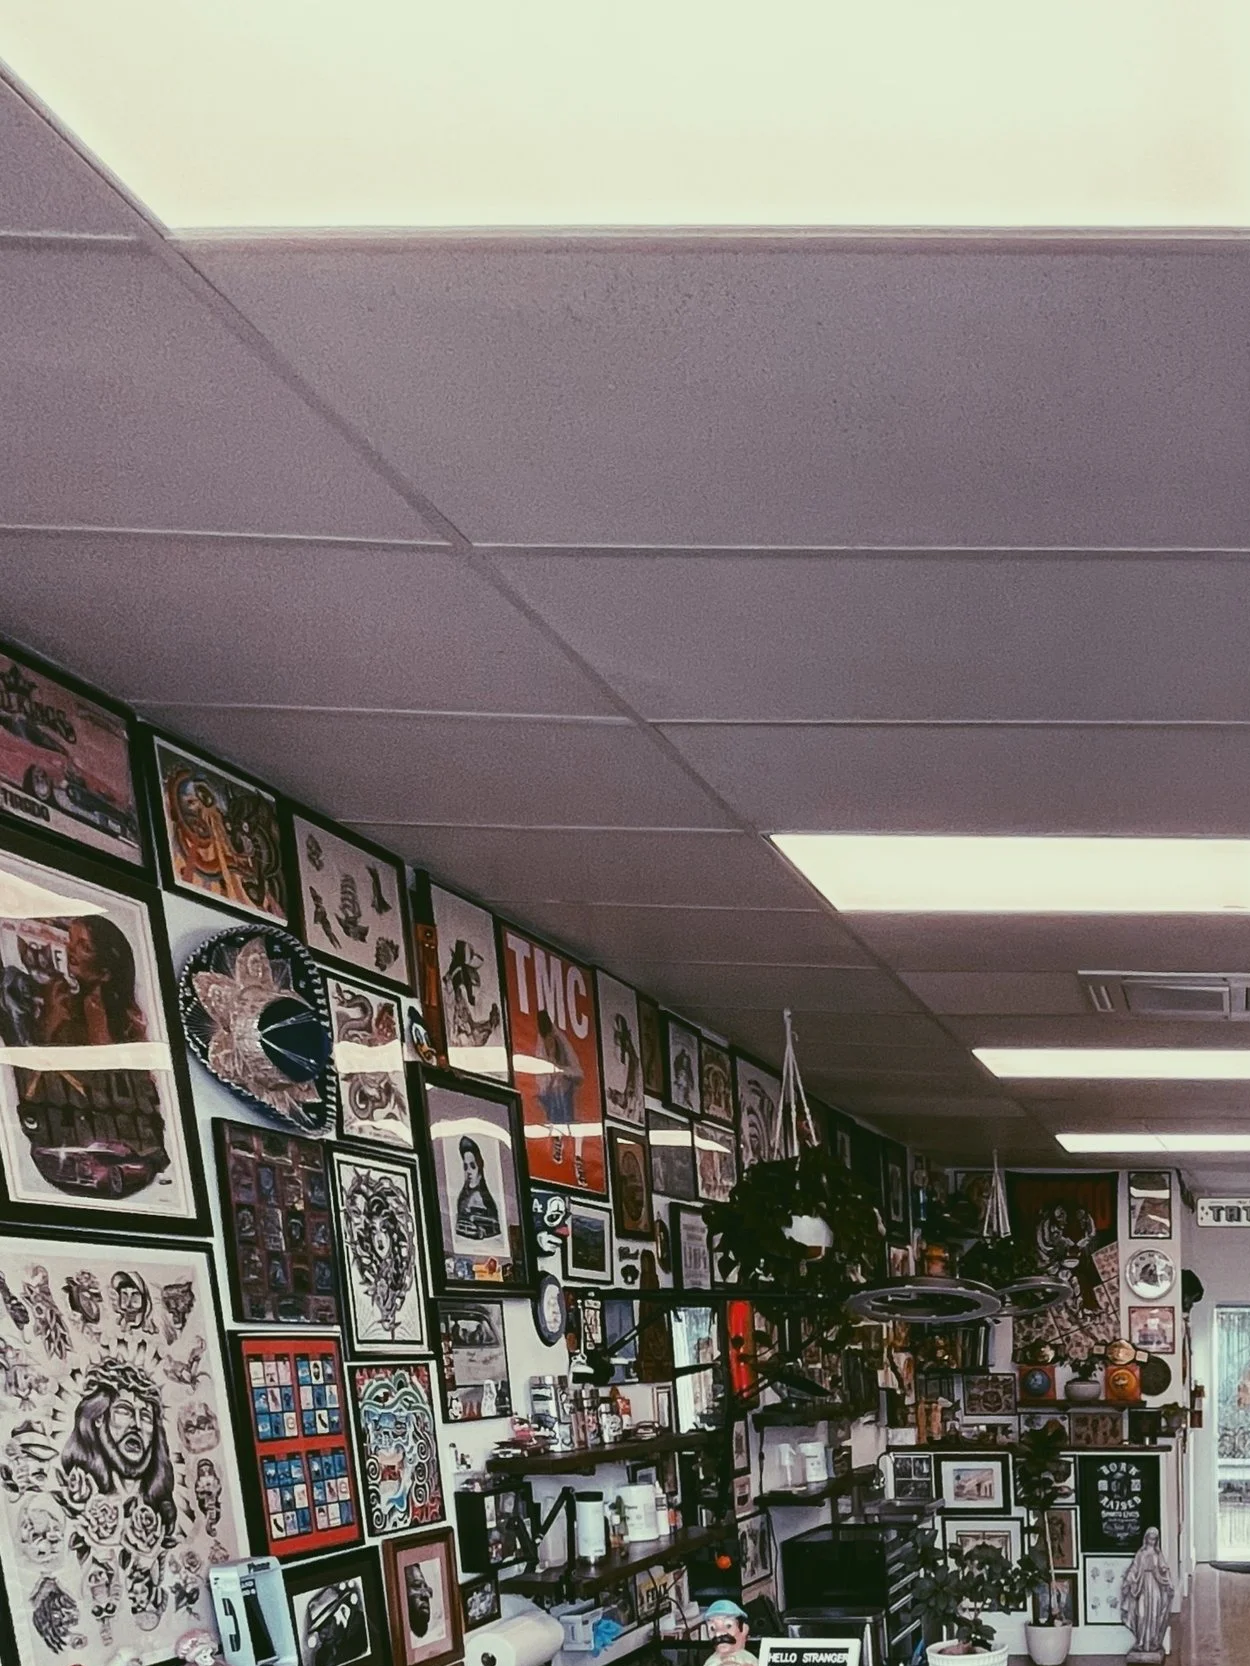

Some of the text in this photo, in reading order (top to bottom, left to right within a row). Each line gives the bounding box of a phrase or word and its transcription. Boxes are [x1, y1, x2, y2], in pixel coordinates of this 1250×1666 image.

[506, 931, 589, 1039] TMC
[1098, 1462, 1141, 1476] BORN
[1100, 1495, 1141, 1511] RAISED
[768, 1652, 849, 1663] HELLO STRANGER
